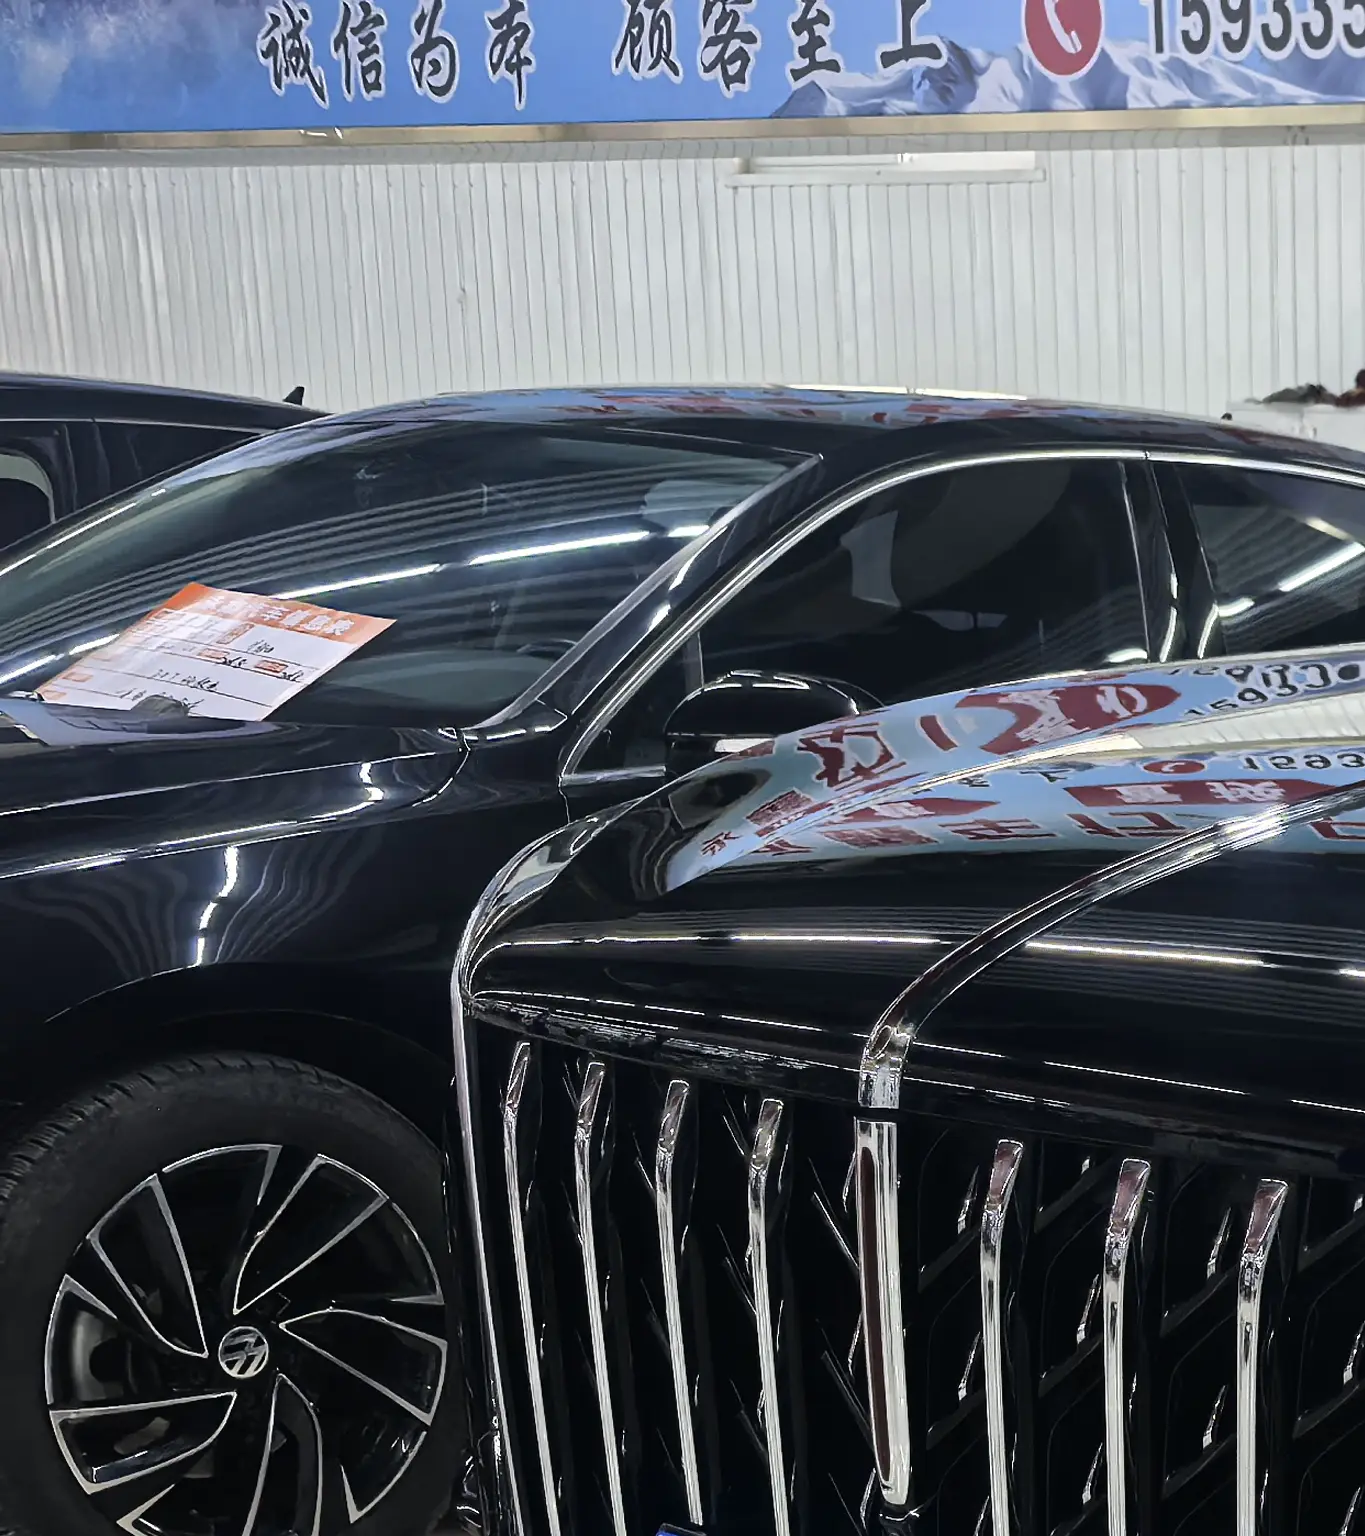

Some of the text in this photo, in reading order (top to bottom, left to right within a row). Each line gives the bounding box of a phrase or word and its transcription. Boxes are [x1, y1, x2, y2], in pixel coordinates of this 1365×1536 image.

[260, 0, 532, 104] 诚信为本
[594, 0, 943, 91] 顾客至上
